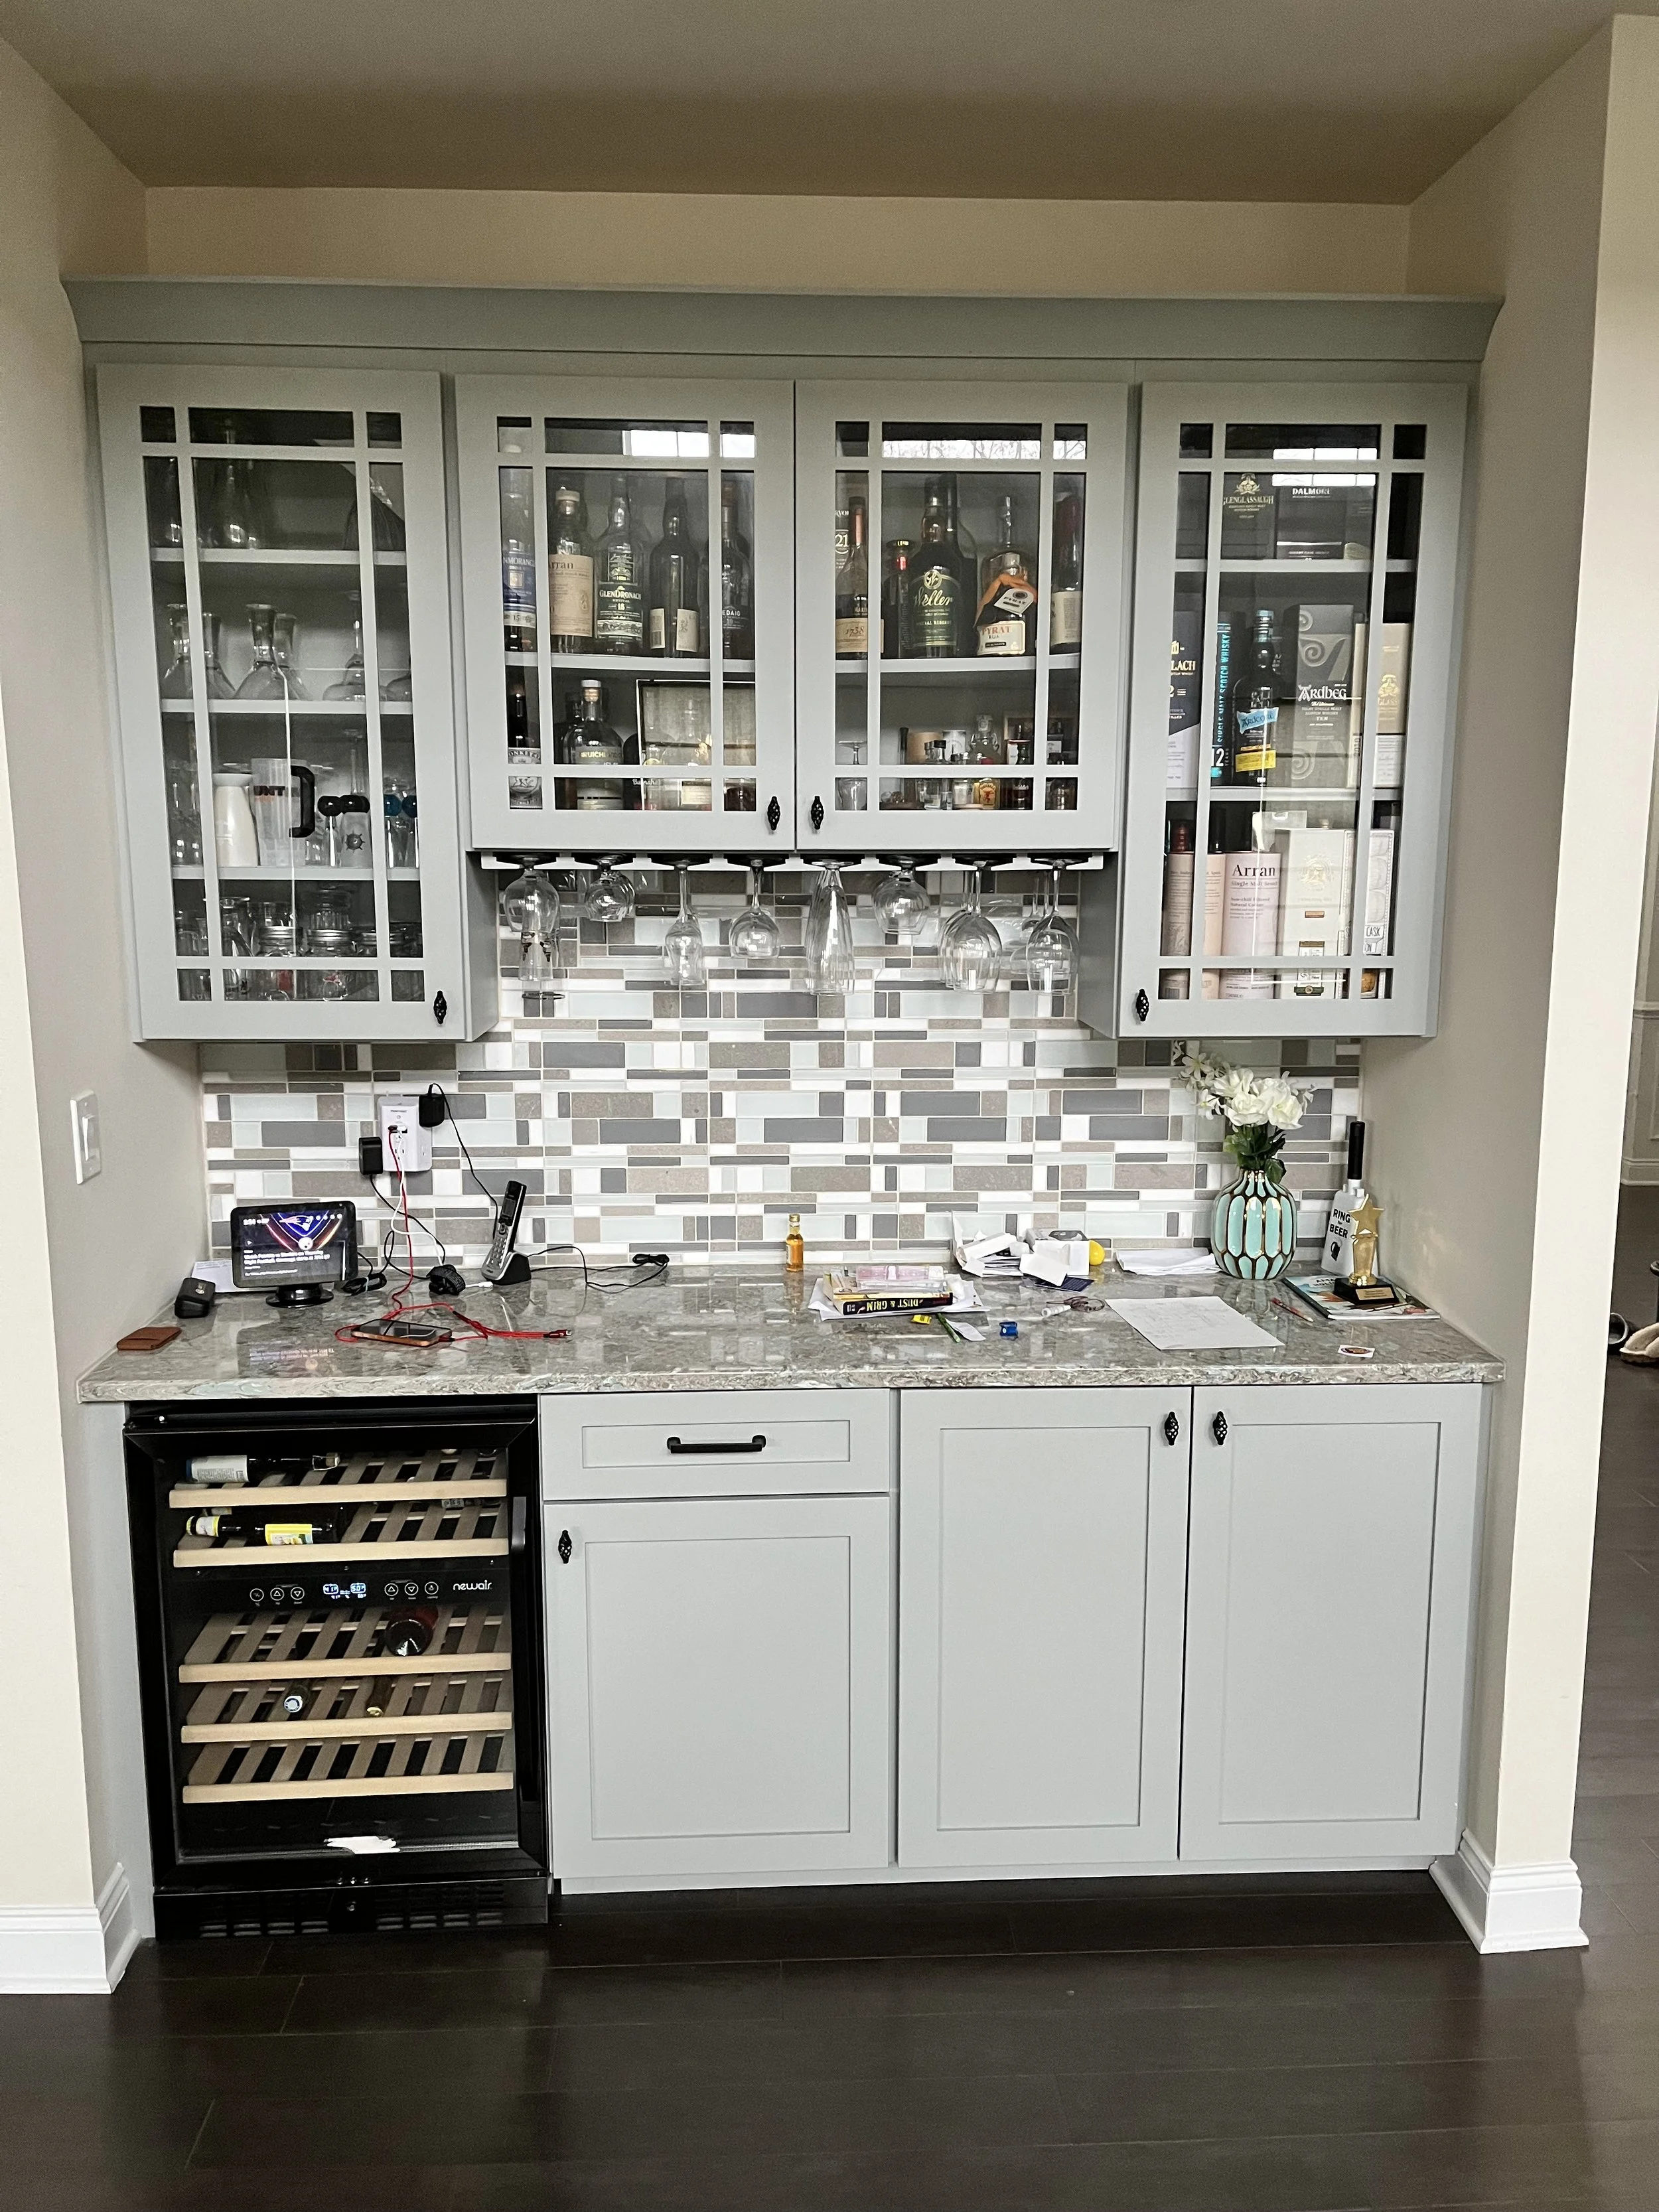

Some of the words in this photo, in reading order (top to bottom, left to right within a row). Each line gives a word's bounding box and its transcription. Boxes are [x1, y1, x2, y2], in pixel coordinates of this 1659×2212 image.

[845, 626, 865, 637] 1738
[982, 626, 1011, 636] PYRAT
[1220, 634, 1230, 663] WHISKY
[1219, 666, 1229, 694] SCOTCH
[1232, 864, 1275, 877] Arran
[1366, 926, 1380, 937] CASK
[1333, 1209, 1350, 1223] RING
[1329, 1224, 1348, 1238] BEER
[867, 1299, 888, 1312] GRIM
[898, 1299, 918, 1307] DUST
[453, 1580, 492, 1591] newair
